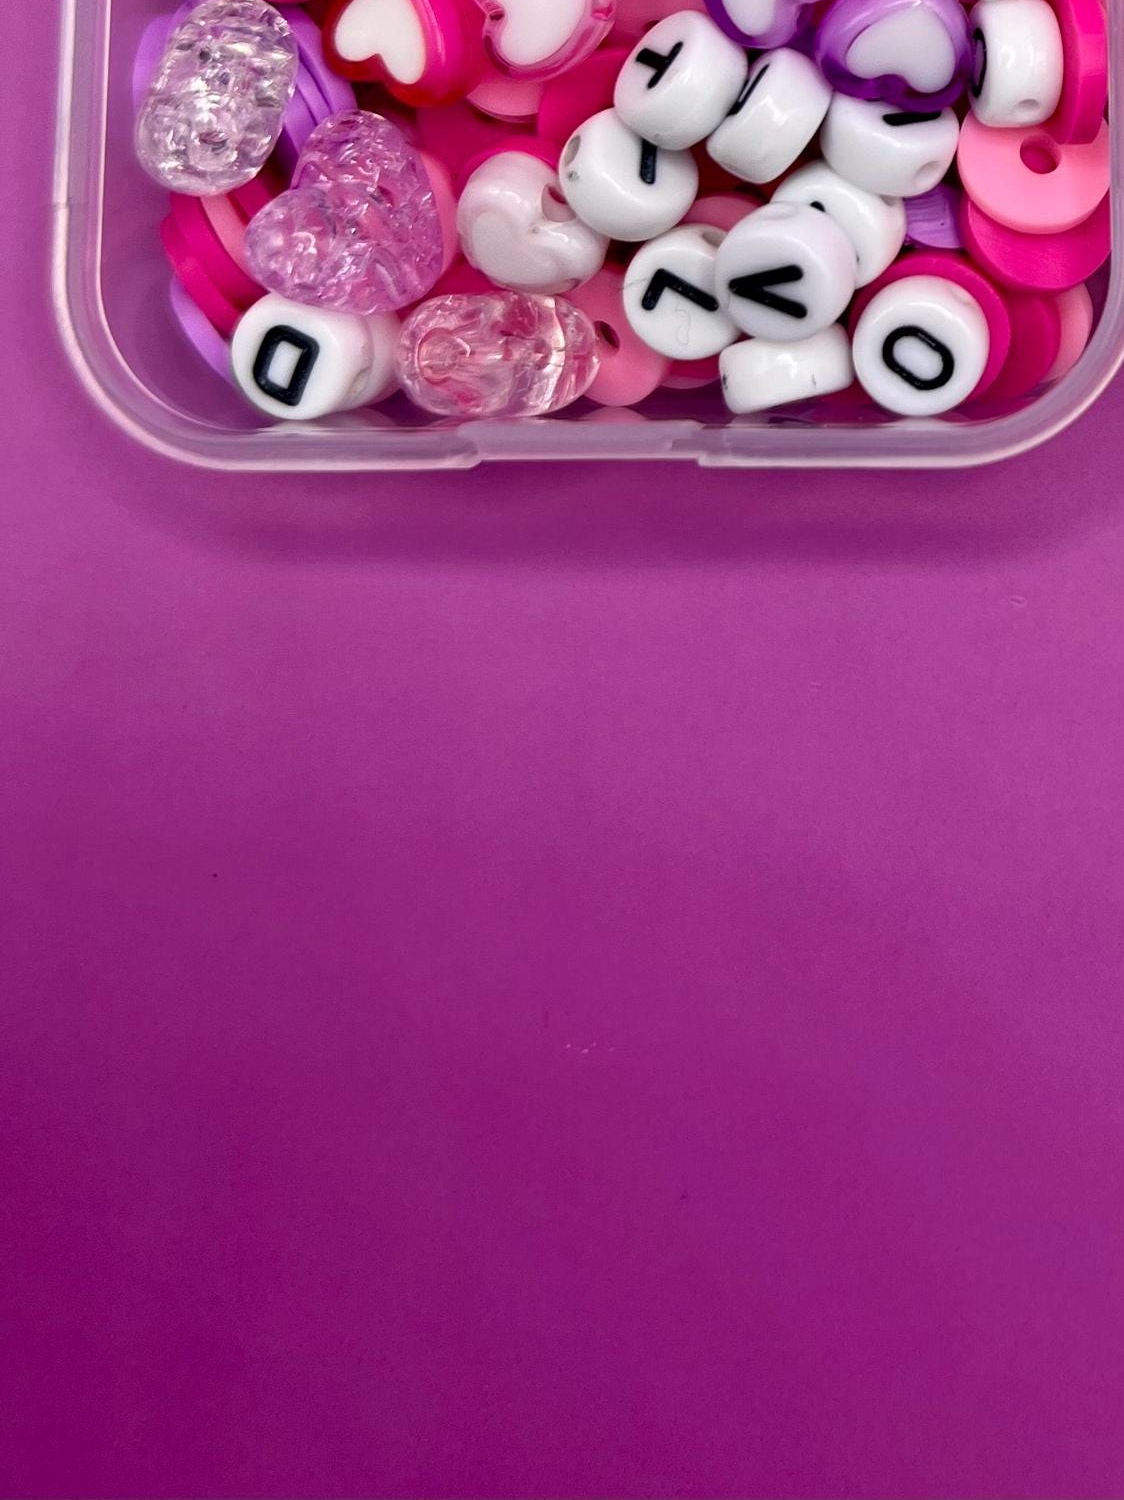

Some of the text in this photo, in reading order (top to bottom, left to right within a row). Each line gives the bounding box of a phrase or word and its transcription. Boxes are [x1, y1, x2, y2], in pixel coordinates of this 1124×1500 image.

[727, 264, 808, 320] V
[252, 324, 319, 407] D
[882, 325, 955, 391] O
